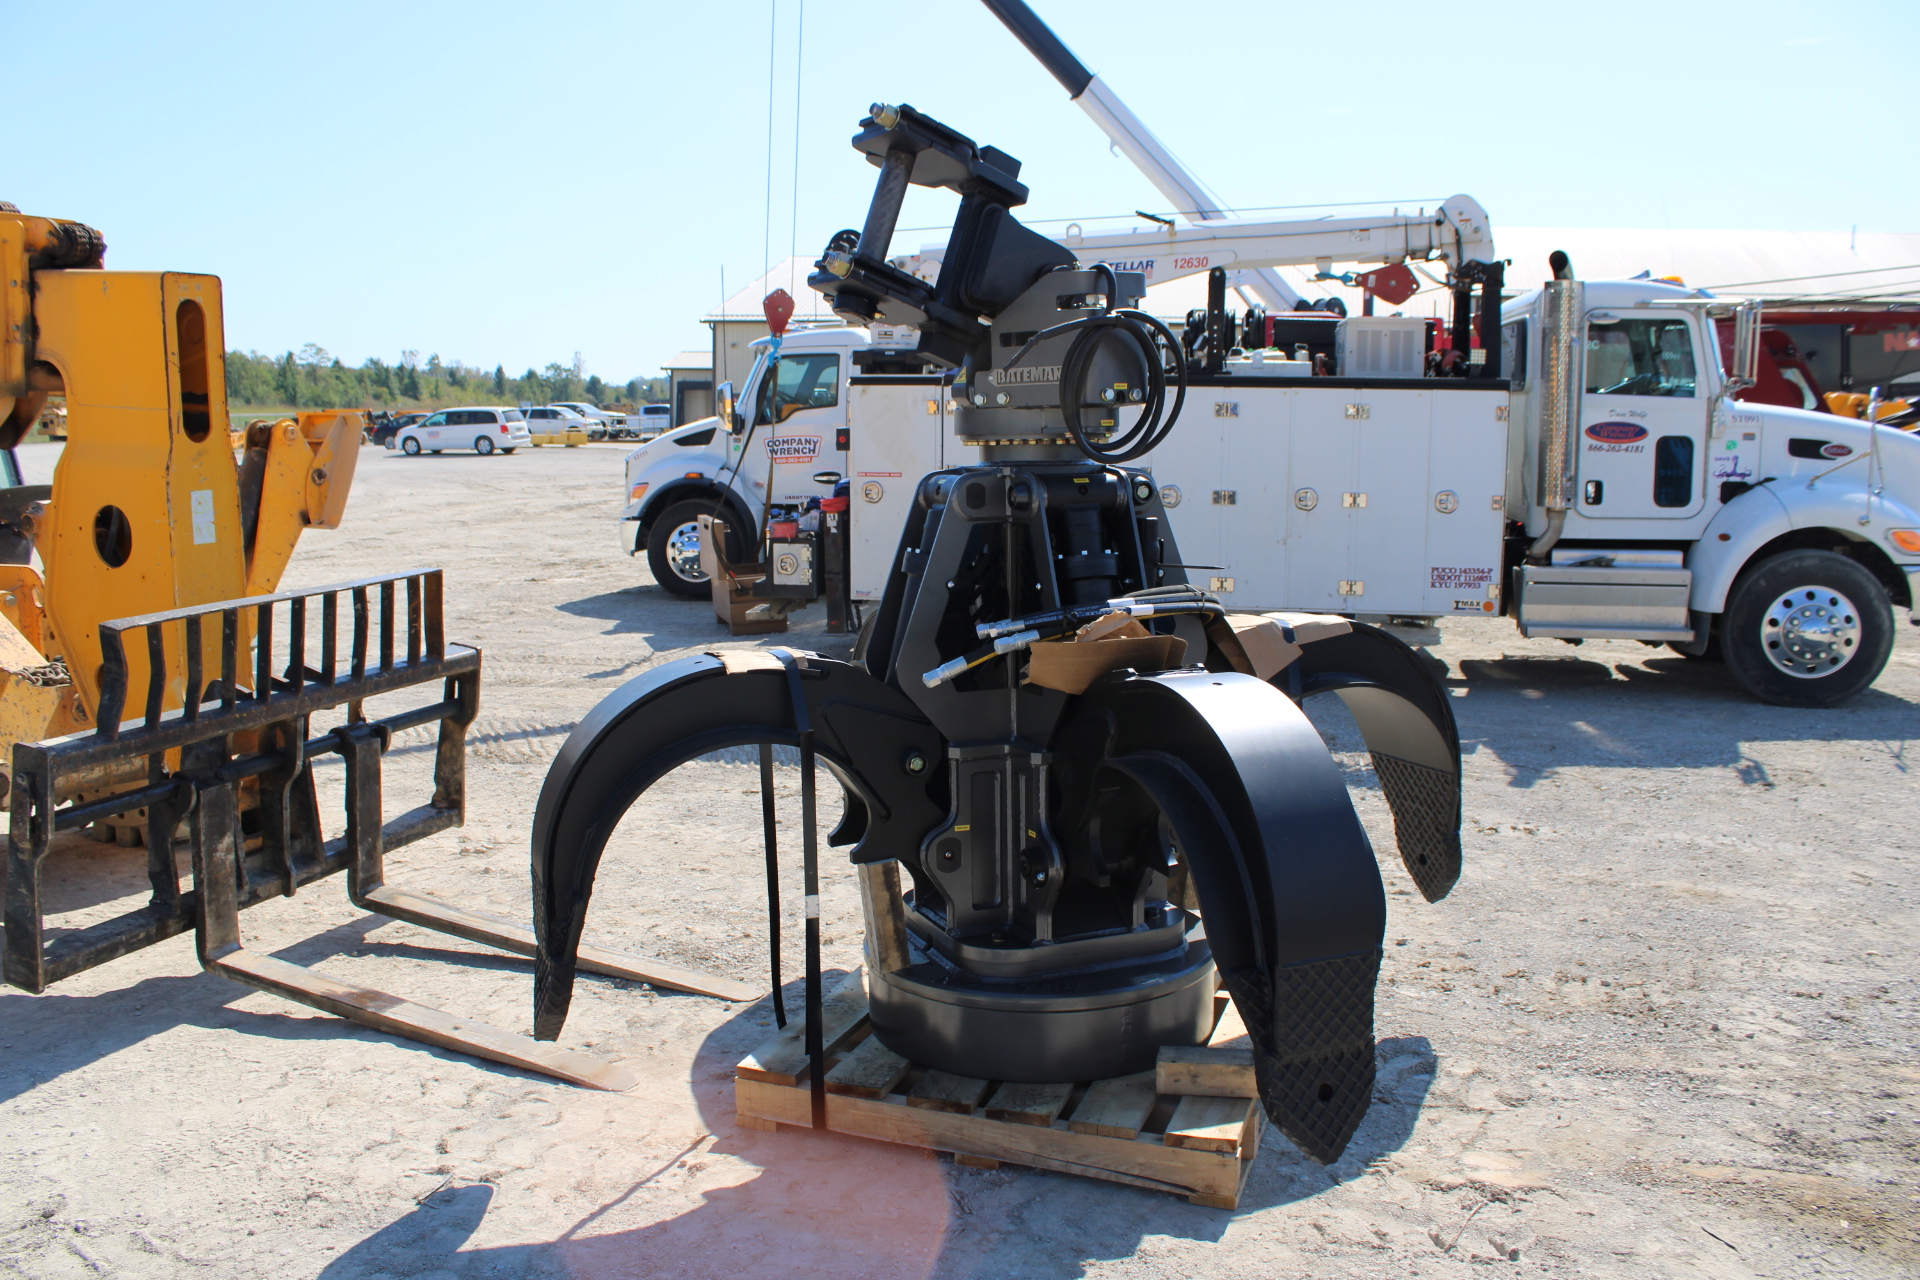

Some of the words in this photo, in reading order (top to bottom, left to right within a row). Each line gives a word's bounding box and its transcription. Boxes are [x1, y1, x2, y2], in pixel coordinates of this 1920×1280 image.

[1103, 259, 1154, 271] TELLAR
[1173, 256, 1208, 269] 12630
[1596, 424, 1640, 433] Company
[1600, 430, 1635, 438] Wrench
[767, 438, 819, 448] COMPANY
[769, 447, 816, 456] WRENCH
[1587, 444, 1645, 453] 866-262-4181
